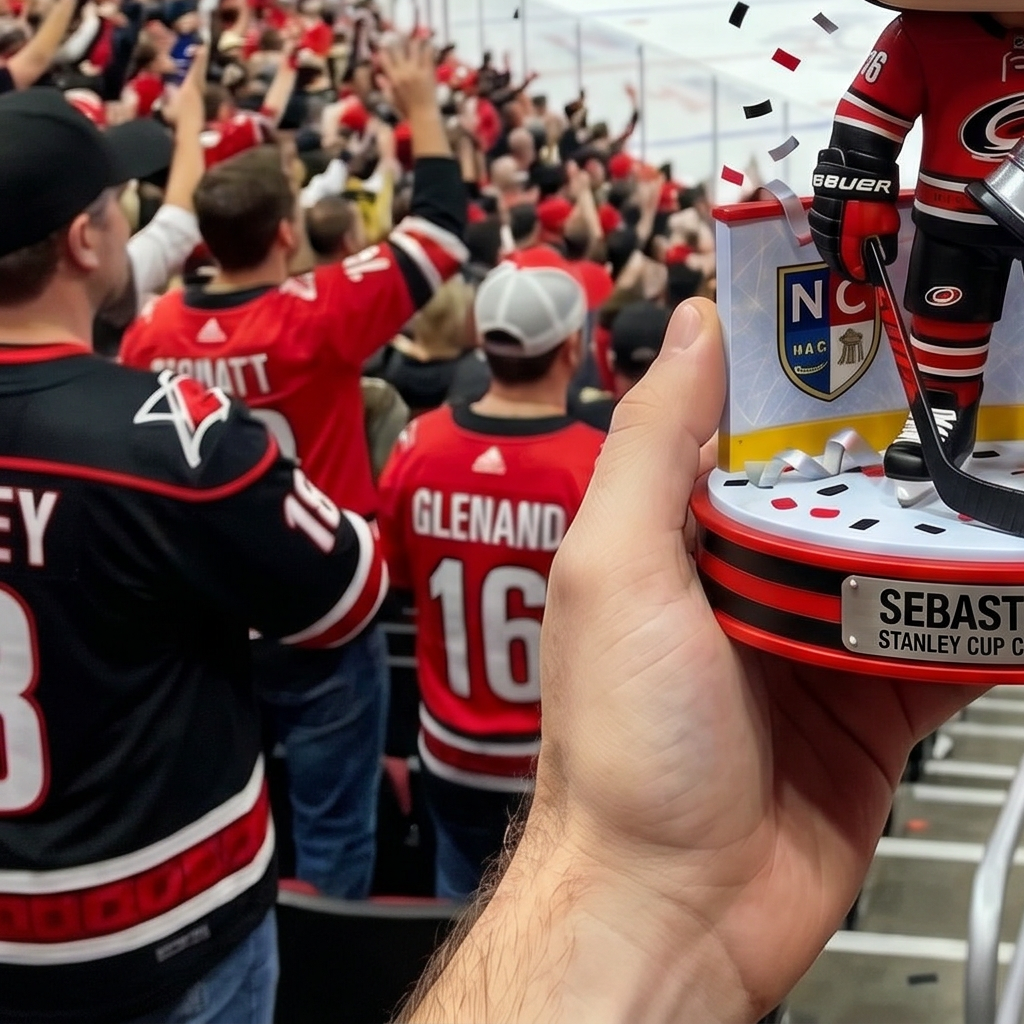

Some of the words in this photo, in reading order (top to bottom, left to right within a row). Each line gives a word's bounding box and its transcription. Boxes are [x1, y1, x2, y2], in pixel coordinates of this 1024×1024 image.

[411, 486, 567, 553] GLENAND
[428, 556, 547, 705] 16
[878, 629, 962, 655] STANLEY
[967, 636, 1005, 656] CUP
